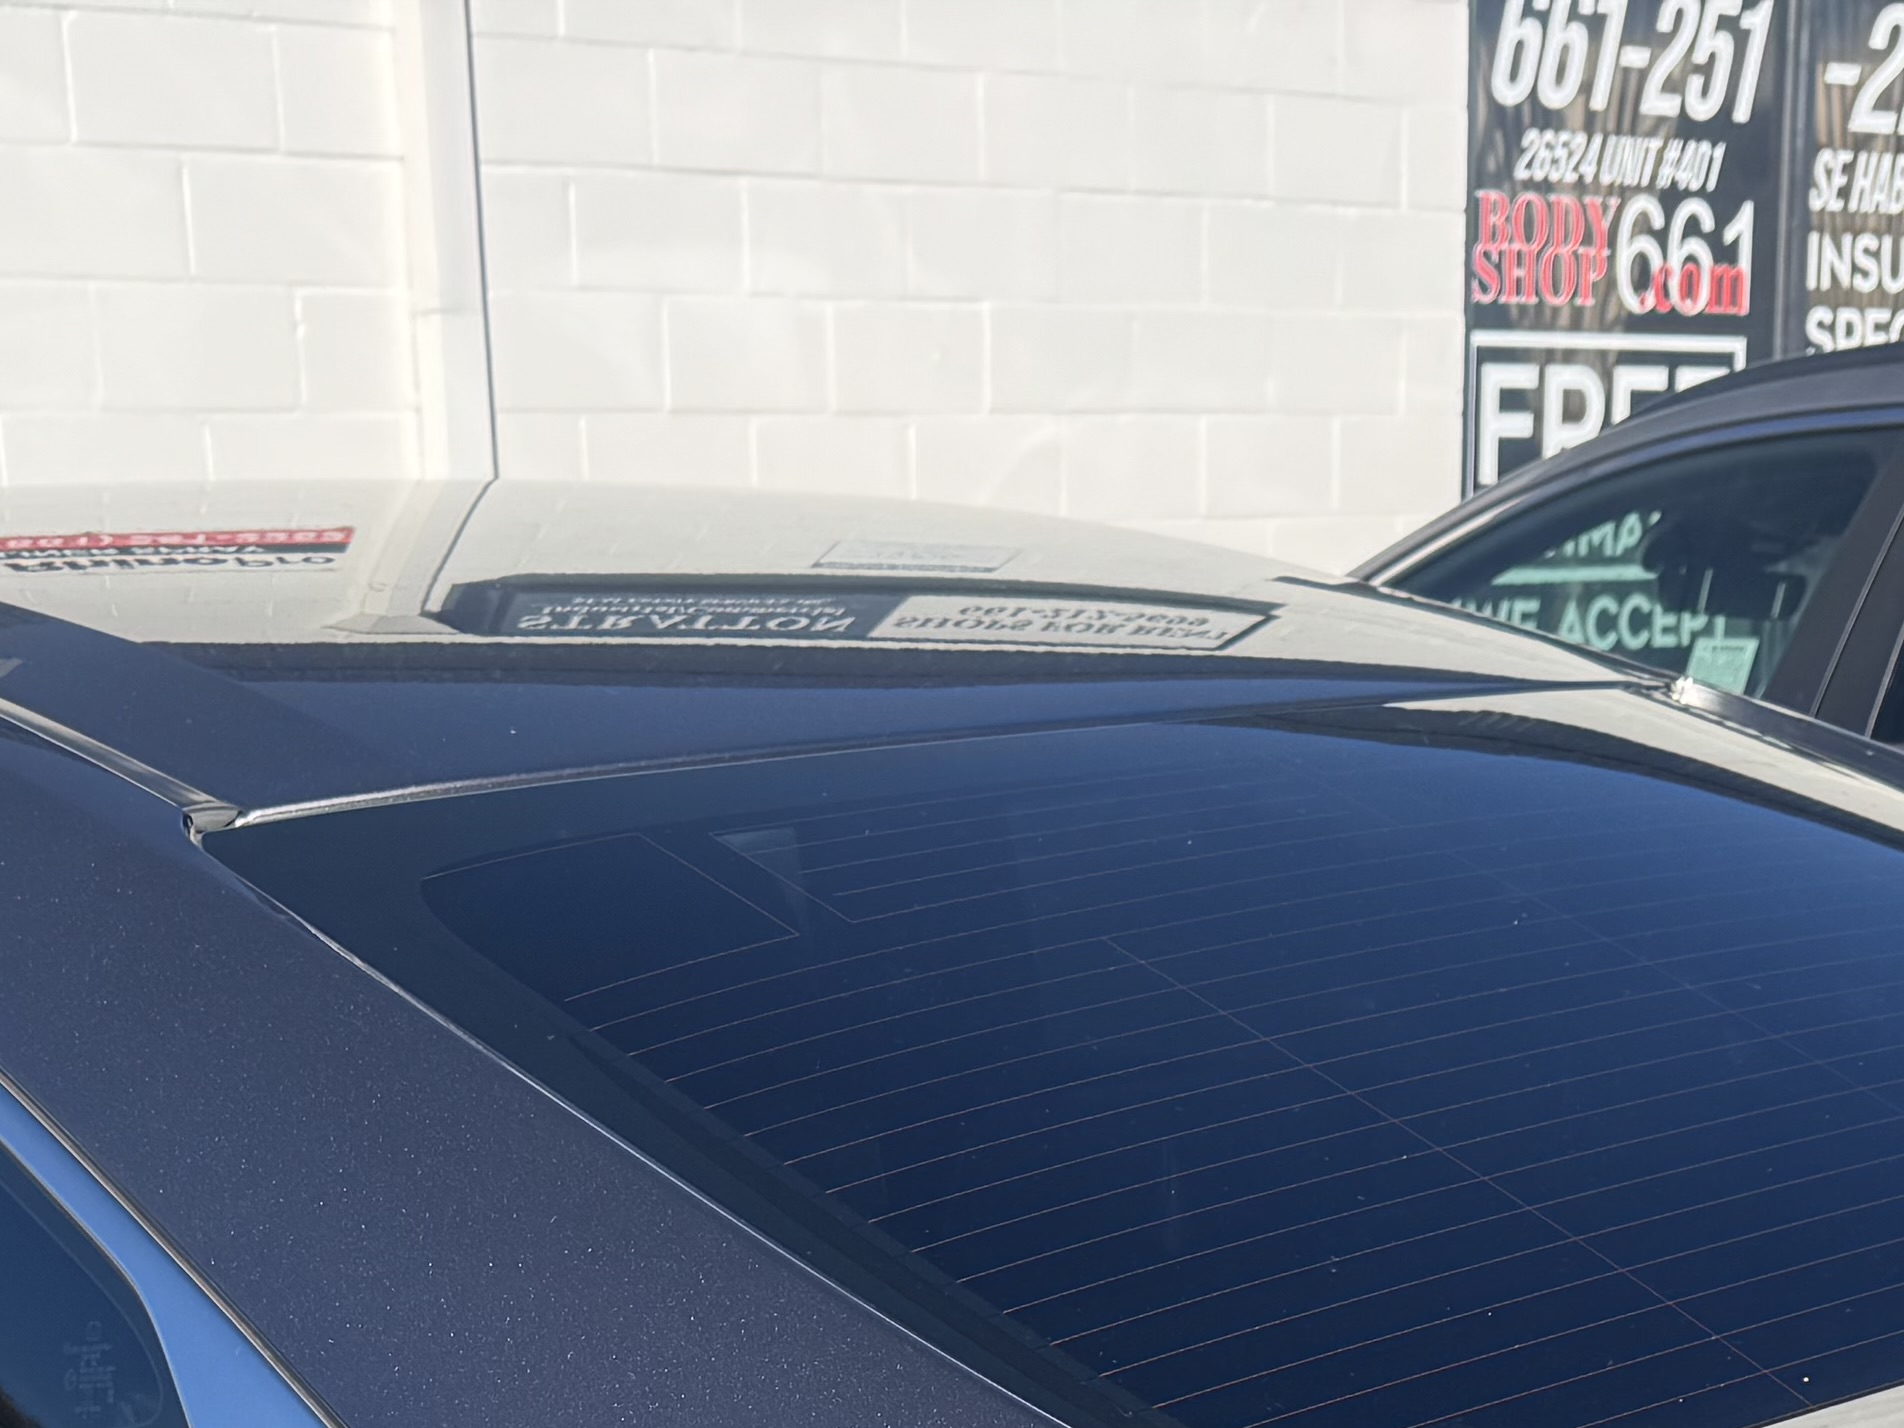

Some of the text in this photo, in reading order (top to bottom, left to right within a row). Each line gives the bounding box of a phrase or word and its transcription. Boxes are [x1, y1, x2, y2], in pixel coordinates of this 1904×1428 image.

[1491, 0, 1773, 123] 661-251
[1514, 127, 1726, 192] 26524 UNIT #401
[1810, 149, 1852, 214] SE
[1476, 189, 1620, 254] BODY
[1472, 244, 1608, 305] SHOP
[1617, 193, 1755, 316] 661
[1636, 262, 1749, 316] .com
[1478, 362, 1730, 487] FR
